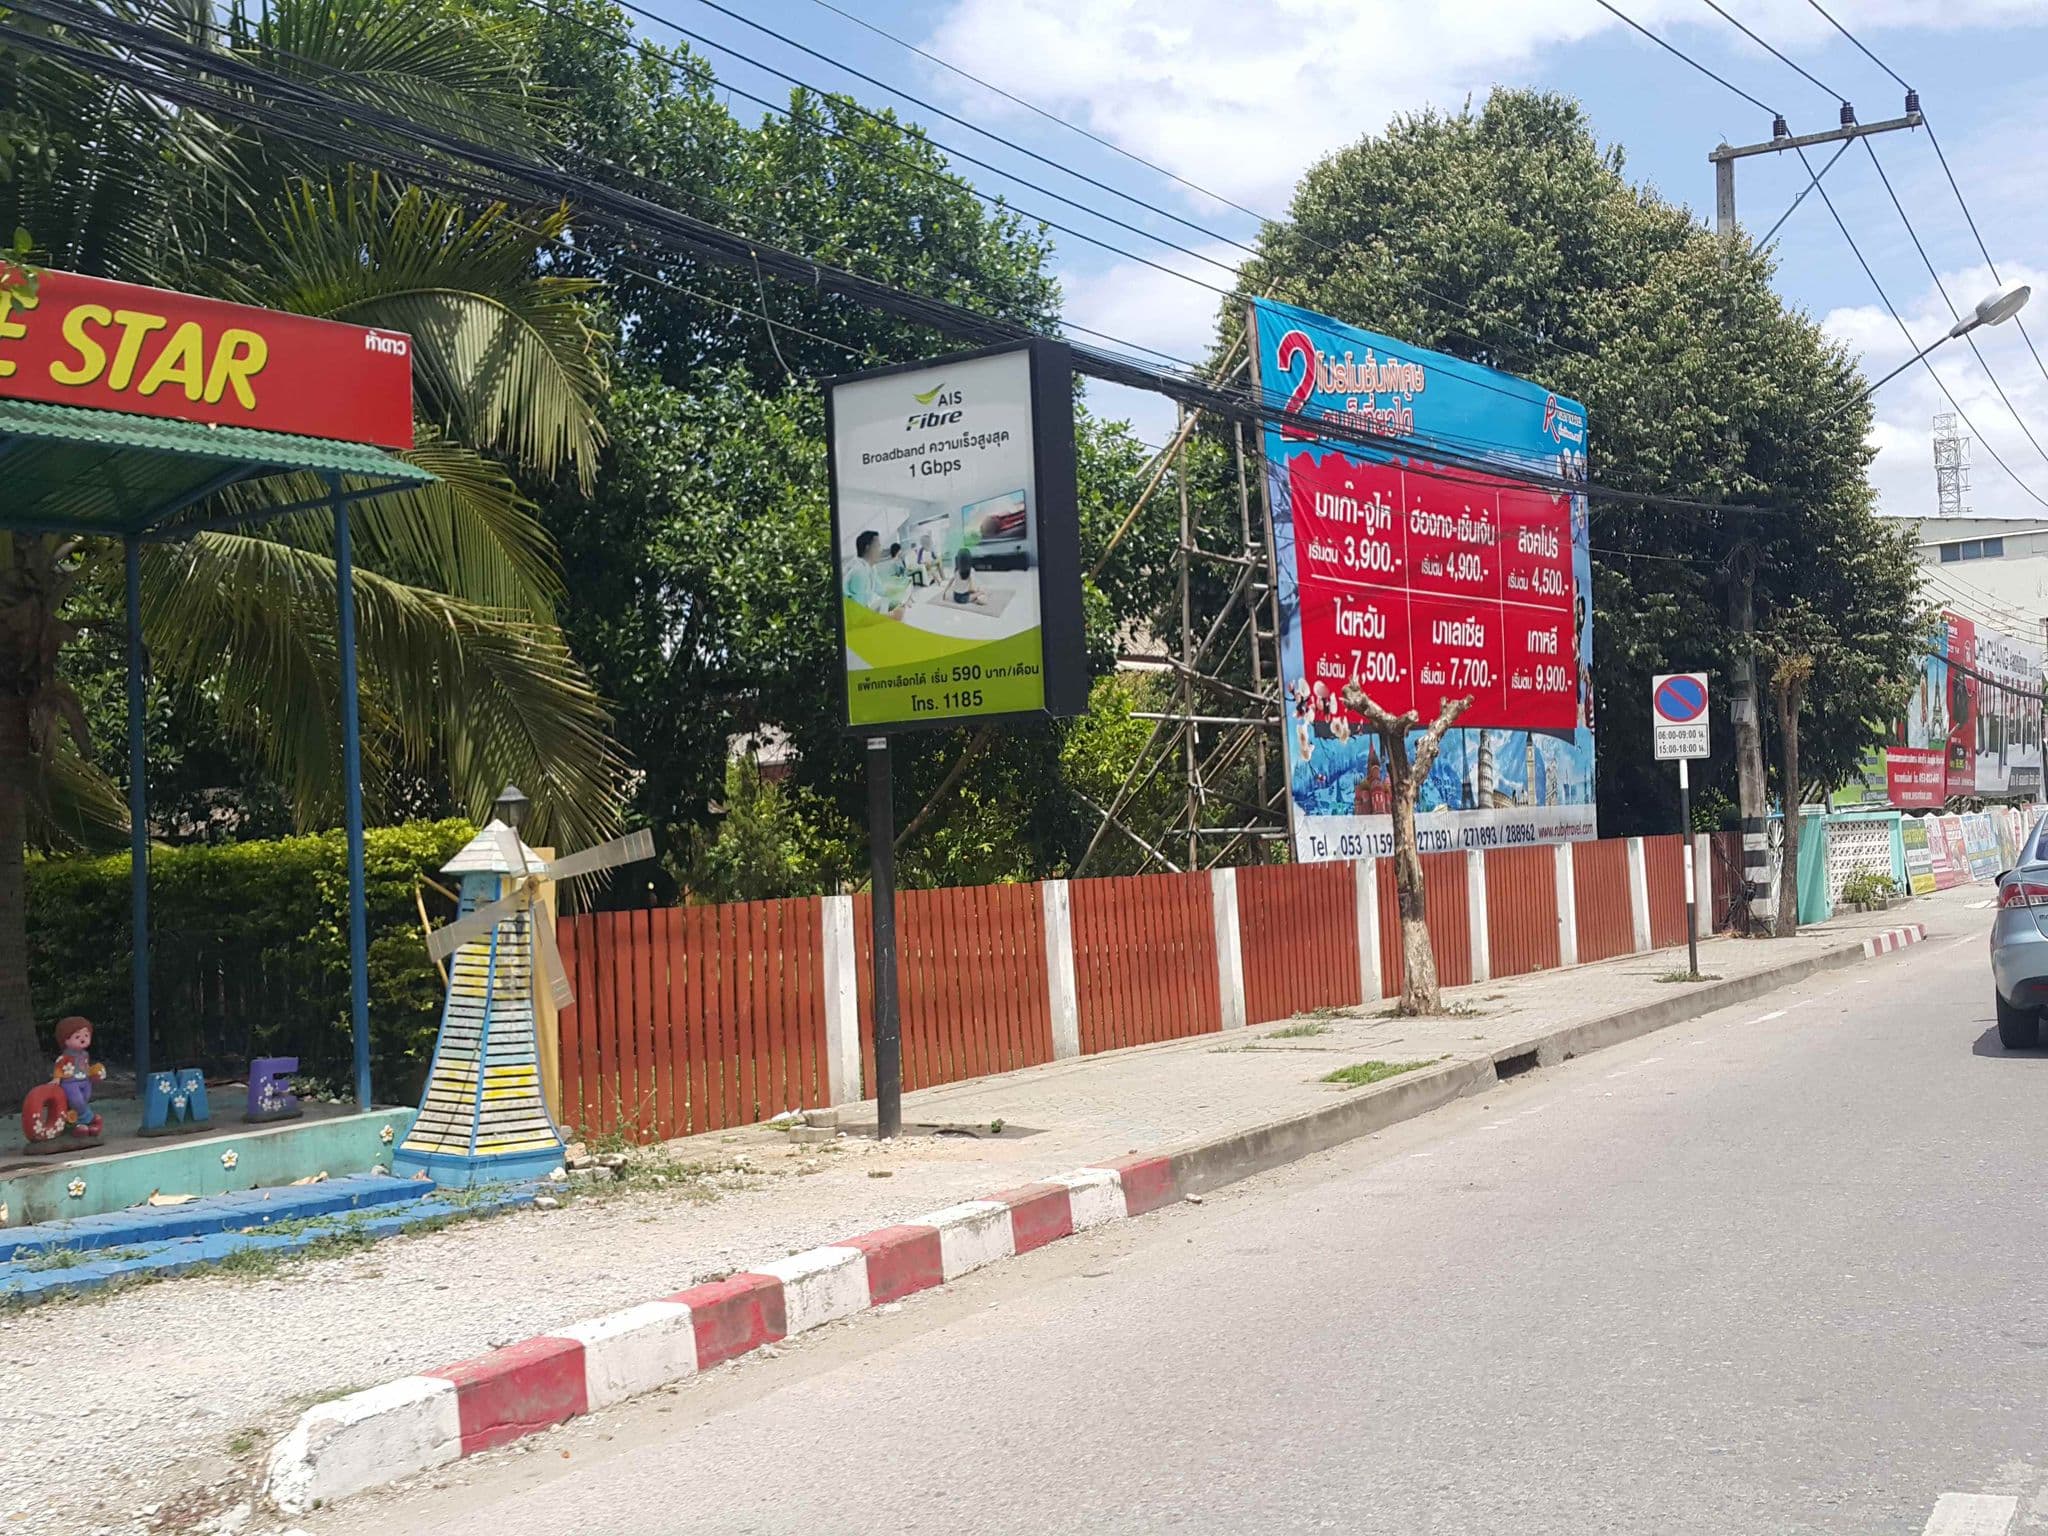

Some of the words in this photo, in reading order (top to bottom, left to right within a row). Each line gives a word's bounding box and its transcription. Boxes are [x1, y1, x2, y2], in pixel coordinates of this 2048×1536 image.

[49, 304, 268, 410] STAR
[1316, 348, 1425, 394] โปรโมชั่นพิเศษ
[937, 391, 962, 407] AIS
[906, 410, 963, 431] Fibre
[862, 443, 926, 465] Broadband
[929, 431, 1009, 453] ความเร็วสูงสุด
[909, 464, 916, 478] 1
[921, 459, 962, 476] Gbps
[1308, 536, 1338, 563] เริ่มต้น
[1343, 536, 1402, 573] 3,900.-
[1518, 525, 1559, 559] สิงคโปร์
[1421, 553, 1443, 577] เริ่มต้น
[1446, 552, 1489, 582] 4,900.-
[1507, 568, 1529, 590] เริ่มต้น
[1531, 567, 1569, 597] 4,500.-
[1333, 594, 1386, 640] ไต้หวัน
[1432, 616, 1485, 648] มาเลเซีย
[1527, 627, 1558, 655] เกาหลี
[931, 668, 948, 684] เริ่ม
[952, 665, 981, 681] 590
[985, 662, 1040, 679] บาท/เดือน
[1316, 652, 1346, 679] เริ่มต้น
[1350, 649, 1407, 685] 7,500.-
[1420, 661, 1445, 686] เริ่มต้น
[1449, 657, 1498, 689] 7,700.-
[1511, 668, 1533, 690] เริ่มต้น
[1535, 664, 1573, 693] 9,900.-
[911, 695, 939, 712] โทร.
[943, 690, 984, 709] 1185
[1340, 834, 1362, 856] 053
[1366, 833, 1393, 855] 1159
[1464, 827, 1497, 847] 271893
[1505, 823, 1536, 844] 288962
